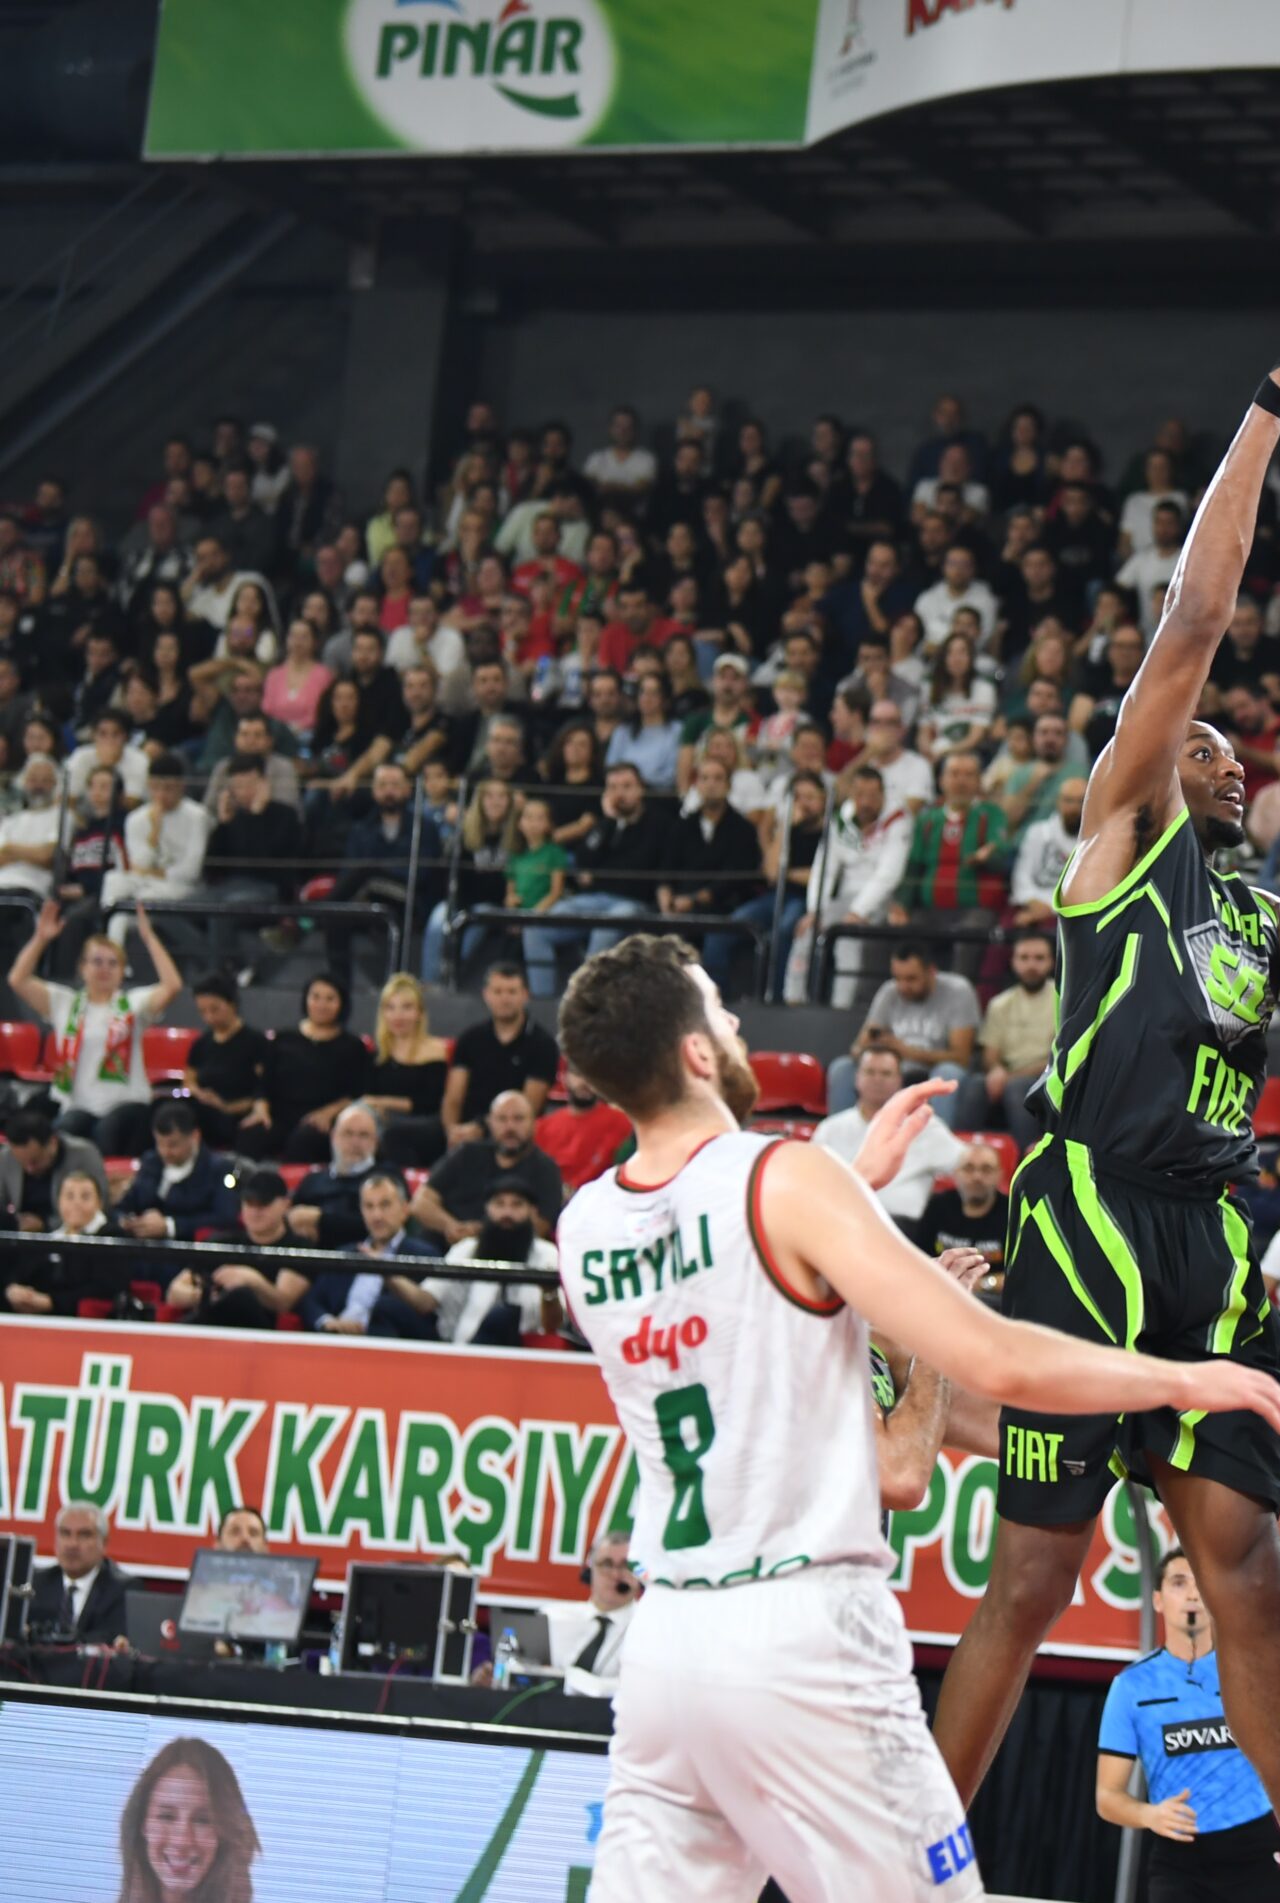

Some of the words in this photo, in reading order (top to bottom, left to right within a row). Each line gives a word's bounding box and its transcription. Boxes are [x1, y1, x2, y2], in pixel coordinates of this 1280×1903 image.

[376, 16, 584, 79] PINAR
[1186, 1043, 1254, 1137] FIAT
[620, 1315, 709, 1371] dyo
[0, 1352, 268, 1536] TÜRK
[654, 1382, 716, 1552] 8
[1005, 1424, 1065, 1483] FIAT
